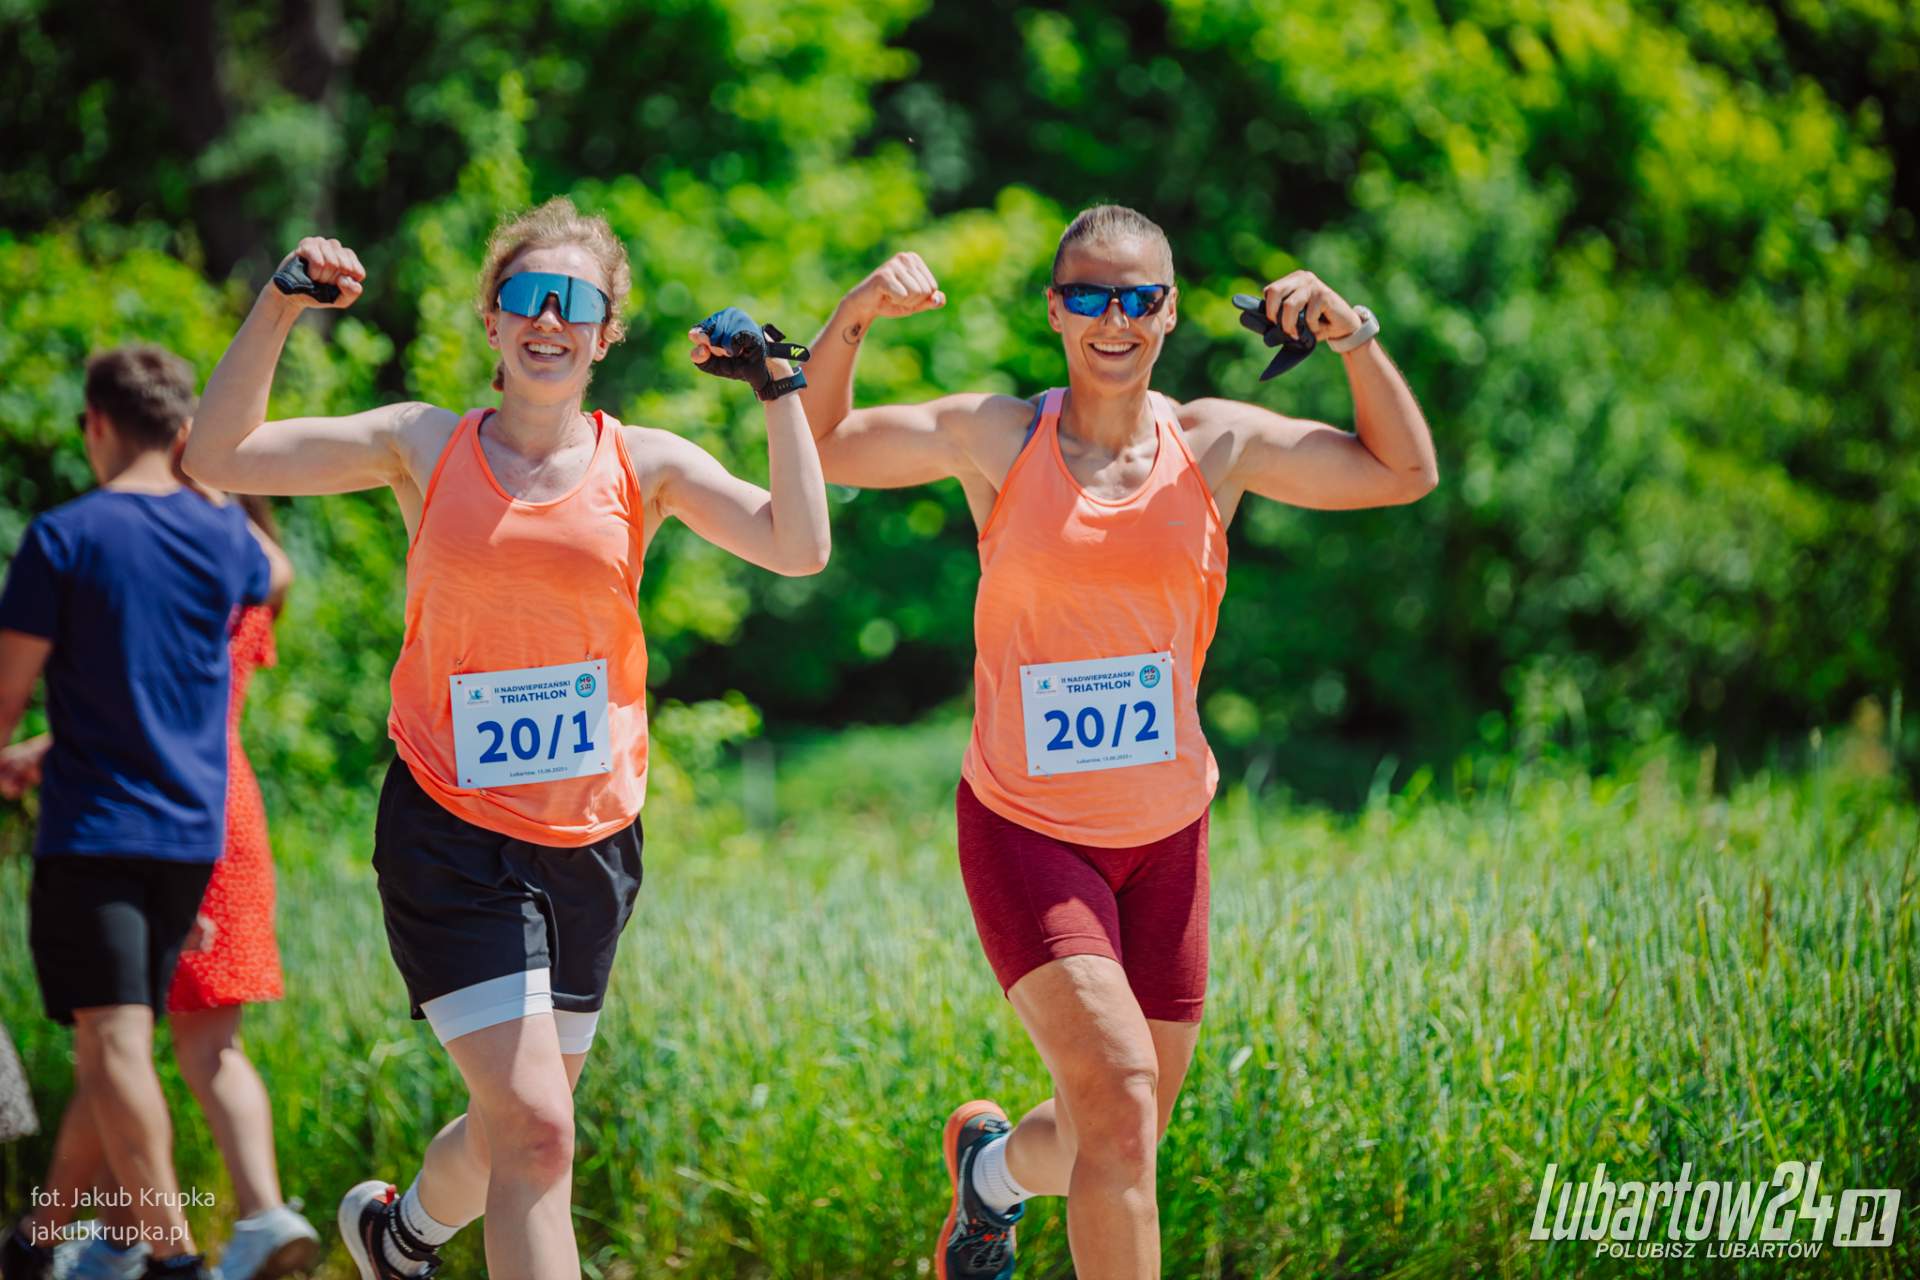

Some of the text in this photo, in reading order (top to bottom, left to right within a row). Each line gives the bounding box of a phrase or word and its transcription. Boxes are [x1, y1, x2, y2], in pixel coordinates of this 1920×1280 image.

[500, 689, 568, 704] TRIATHLON
[1066, 679, 1132, 694] TRIATHLON
[476, 710, 595, 764] 20/1
[1044, 700, 1159, 751] 20/2
